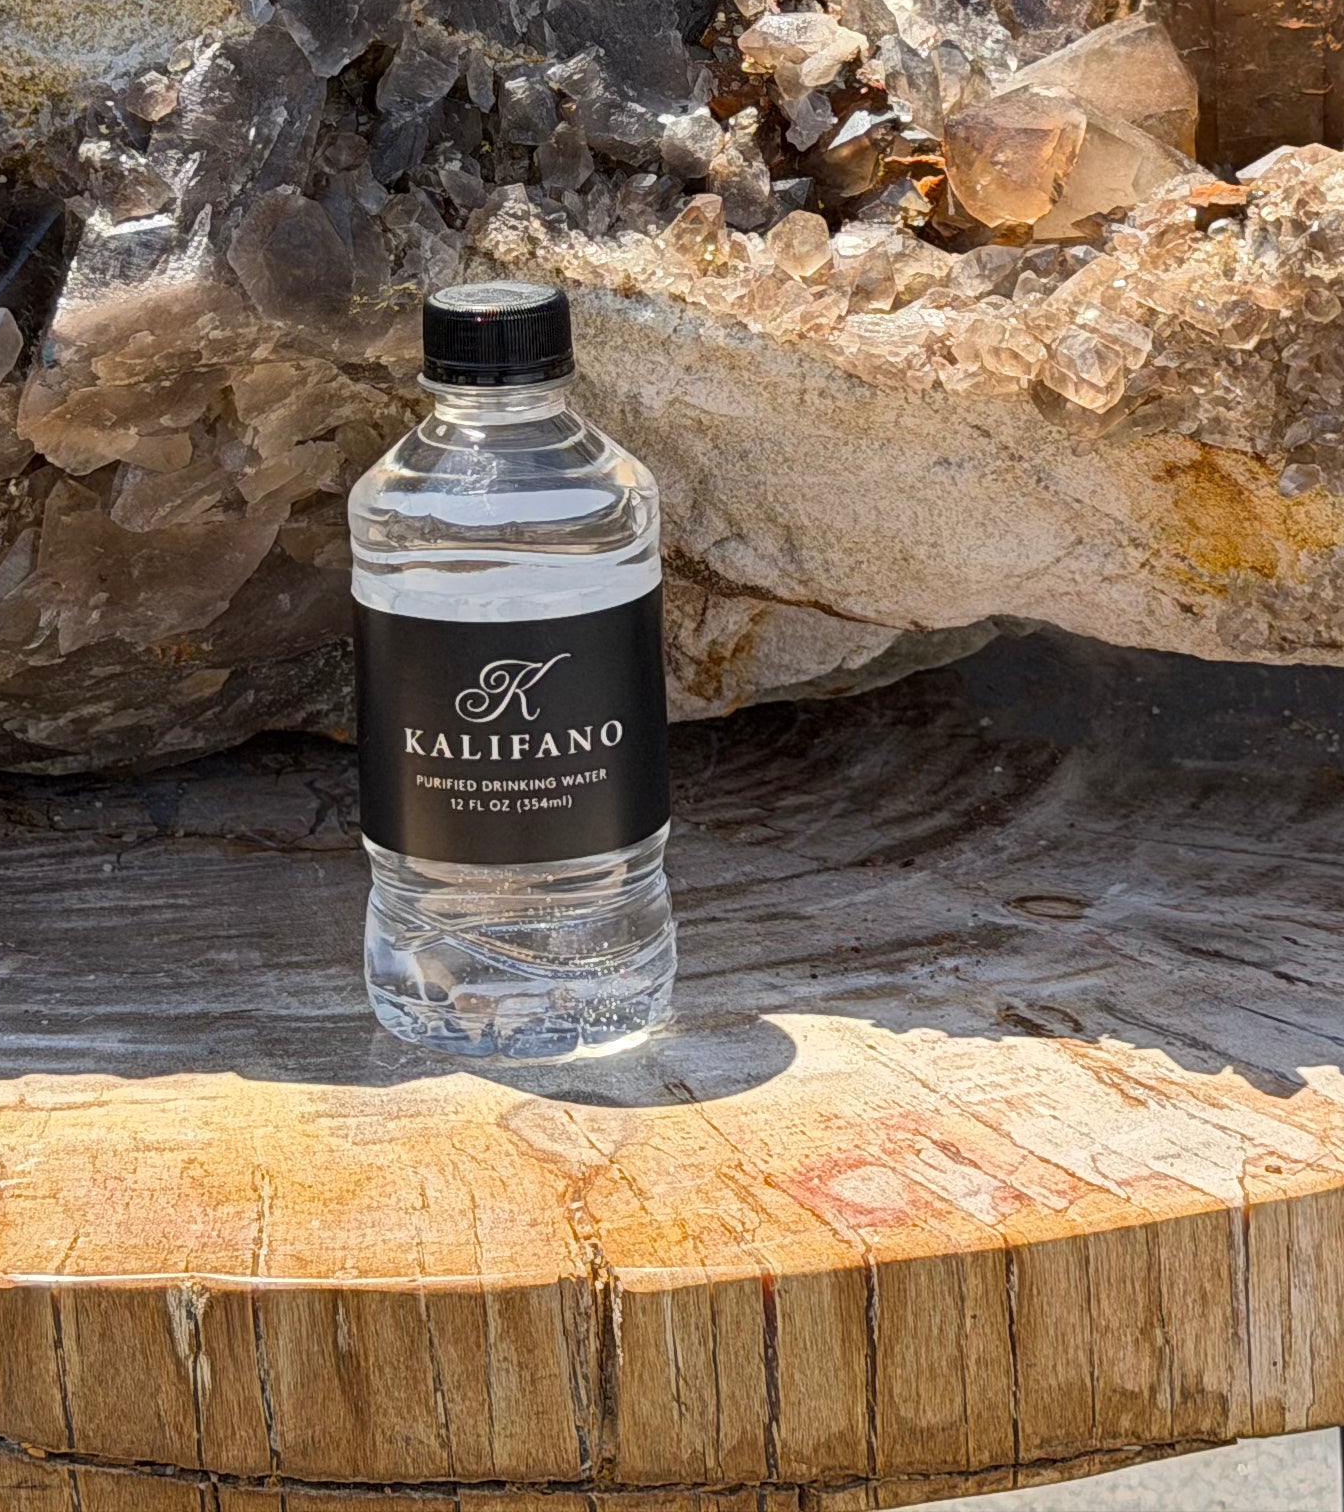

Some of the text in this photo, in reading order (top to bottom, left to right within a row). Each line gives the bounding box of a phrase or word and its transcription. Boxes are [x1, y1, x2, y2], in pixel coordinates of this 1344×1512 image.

[455, 652, 571, 723] K
[404, 720, 623, 760] KALIFANO
[416, 767, 607, 792] PURIFIED DRINKING WATER
[450, 795, 573, 813] 12 FL OZ (354ml)
